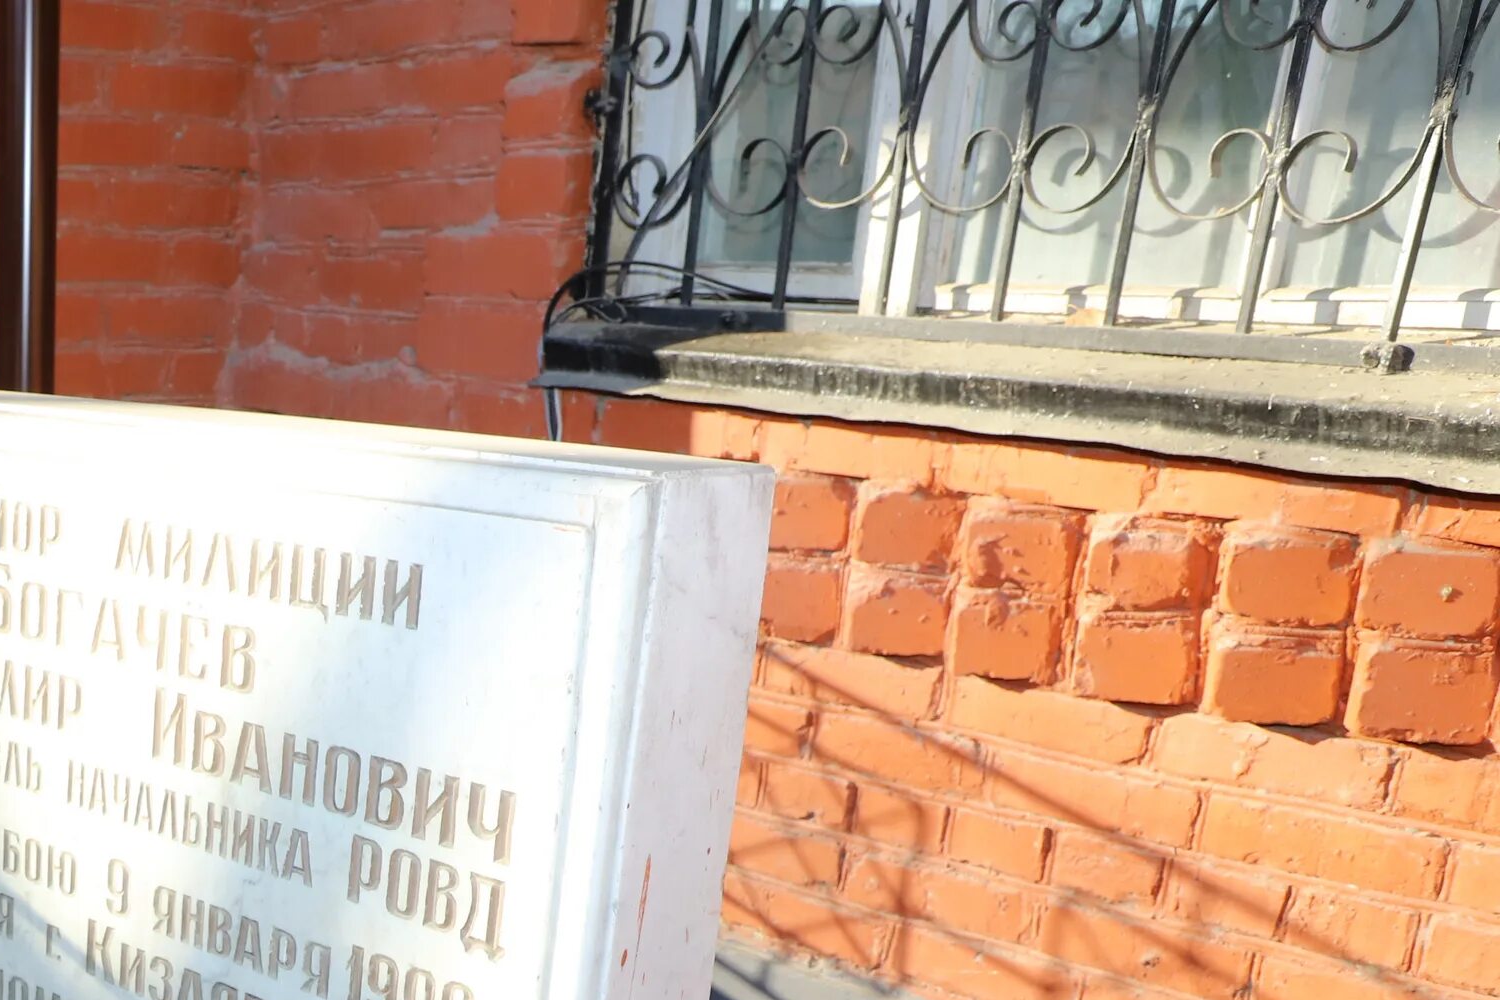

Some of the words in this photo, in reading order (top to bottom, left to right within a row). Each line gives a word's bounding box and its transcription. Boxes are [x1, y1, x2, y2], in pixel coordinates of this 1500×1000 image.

[115, 517, 424, 631] МИЛИЦИИ
[66, 759, 313, 888] НАЧАЛЬНИКА
[347, 833, 506, 963] РОВД
[151, 686, 516, 866] ИВАНОВИЧ
[3, 828, 77, 895] БОЮ
[105, 858, 131, 917] 9
[152, 885, 332, 1000] ЯНВАРЯ
